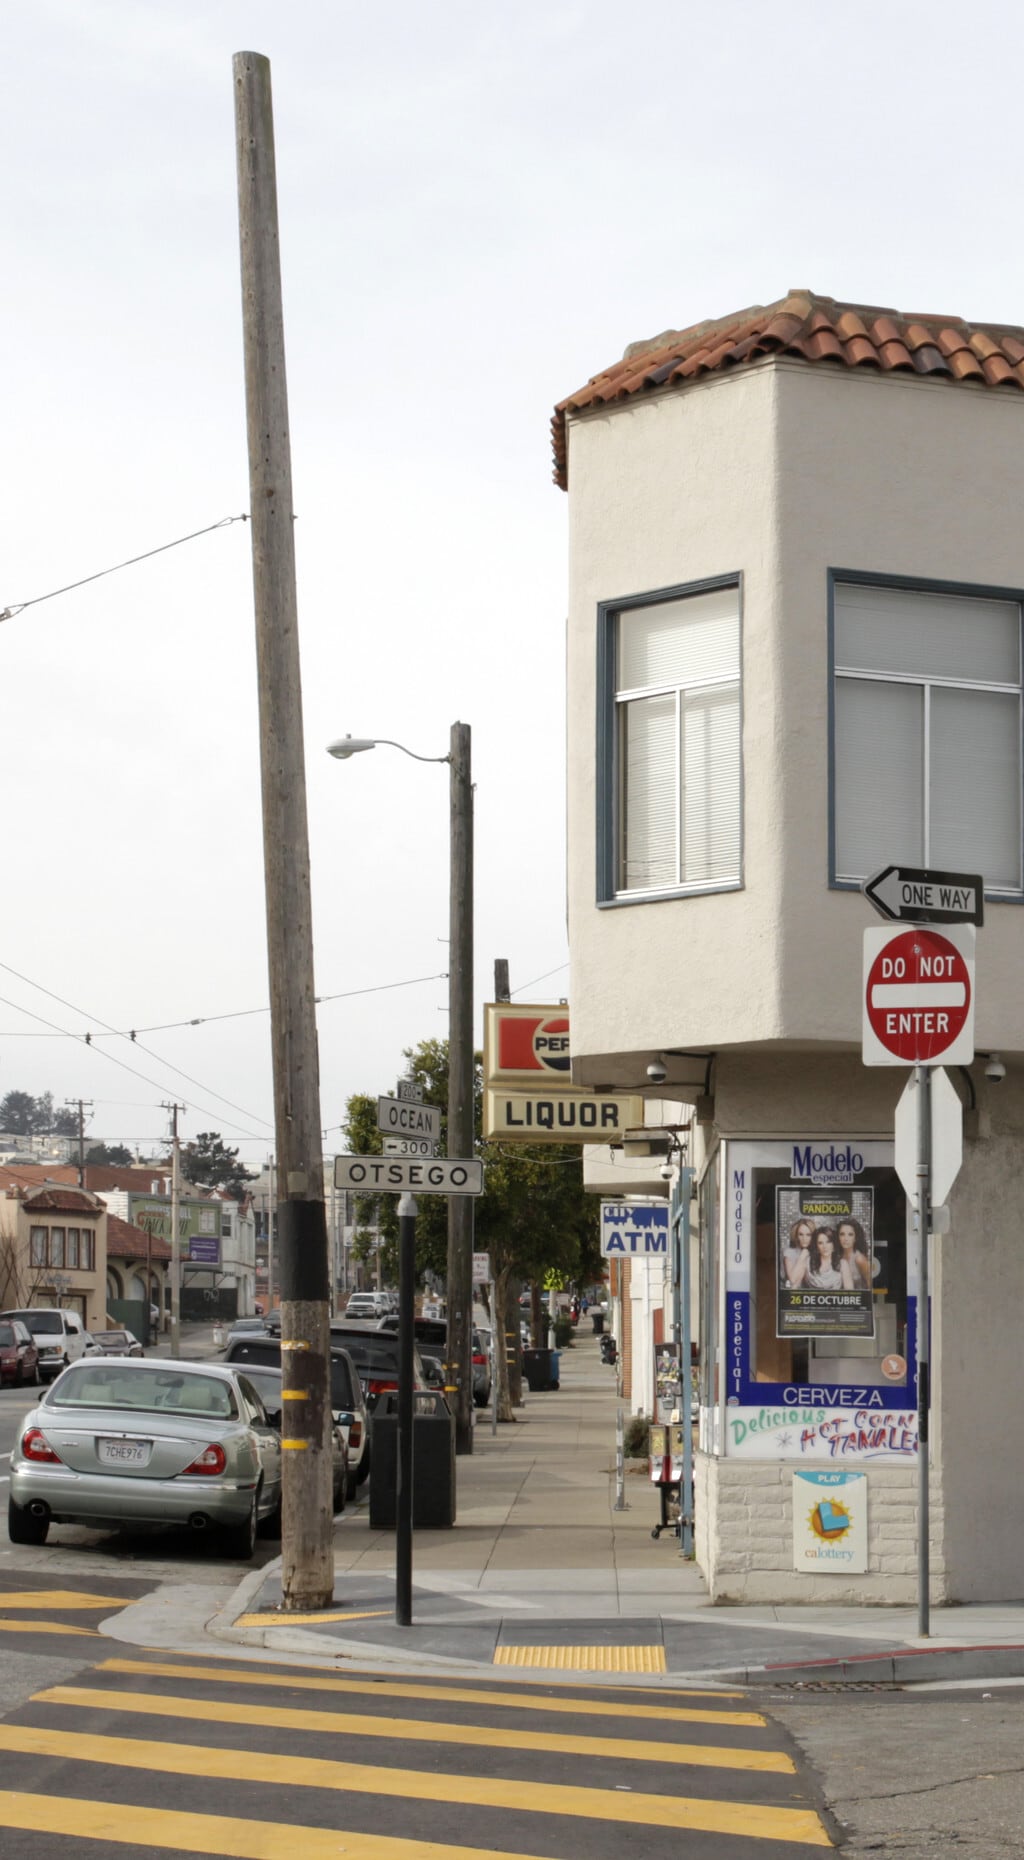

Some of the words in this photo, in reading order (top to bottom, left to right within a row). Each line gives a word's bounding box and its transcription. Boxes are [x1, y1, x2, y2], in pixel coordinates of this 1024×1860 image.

[902, 884, 933, 906] ONE
[939, 888, 971, 910] WAY
[882, 957, 906, 978] DO
[920, 956, 955, 977] NOT
[886, 1013, 949, 1034] ENTER
[535, 1037, 570, 1051] PEP
[403, 1085, 416, 1097] 200
[389, 1106, 433, 1132] OCEAN
[506, 1101, 619, 1129] LIQUOR
[400, 1142, 428, 1154] 300
[793, 1145, 864, 1177] Modelo
[349, 1164, 468, 1186] OTSEGO
[813, 1172, 852, 1183] especial
[604, 1207, 635, 1218] CITY
[733, 1169, 745, 1264] Modelo
[802, 1204, 850, 1214] PANDORA
[606, 1231, 667, 1252] ATM
[790, 1295, 802, 1305] 26
[803, 1295, 816, 1305] DE
[817, 1295, 862, 1306] OCTUBRE
[733, 1300, 743, 1393] especial
[783, 1387, 884, 1407] CERVEZA
[730, 1408, 827, 1446] Delicious
[105, 1446, 143, 1459] 7CHE976
[818, 1475, 841, 1483] PLAY
[805, 1547, 855, 1562] calottery
